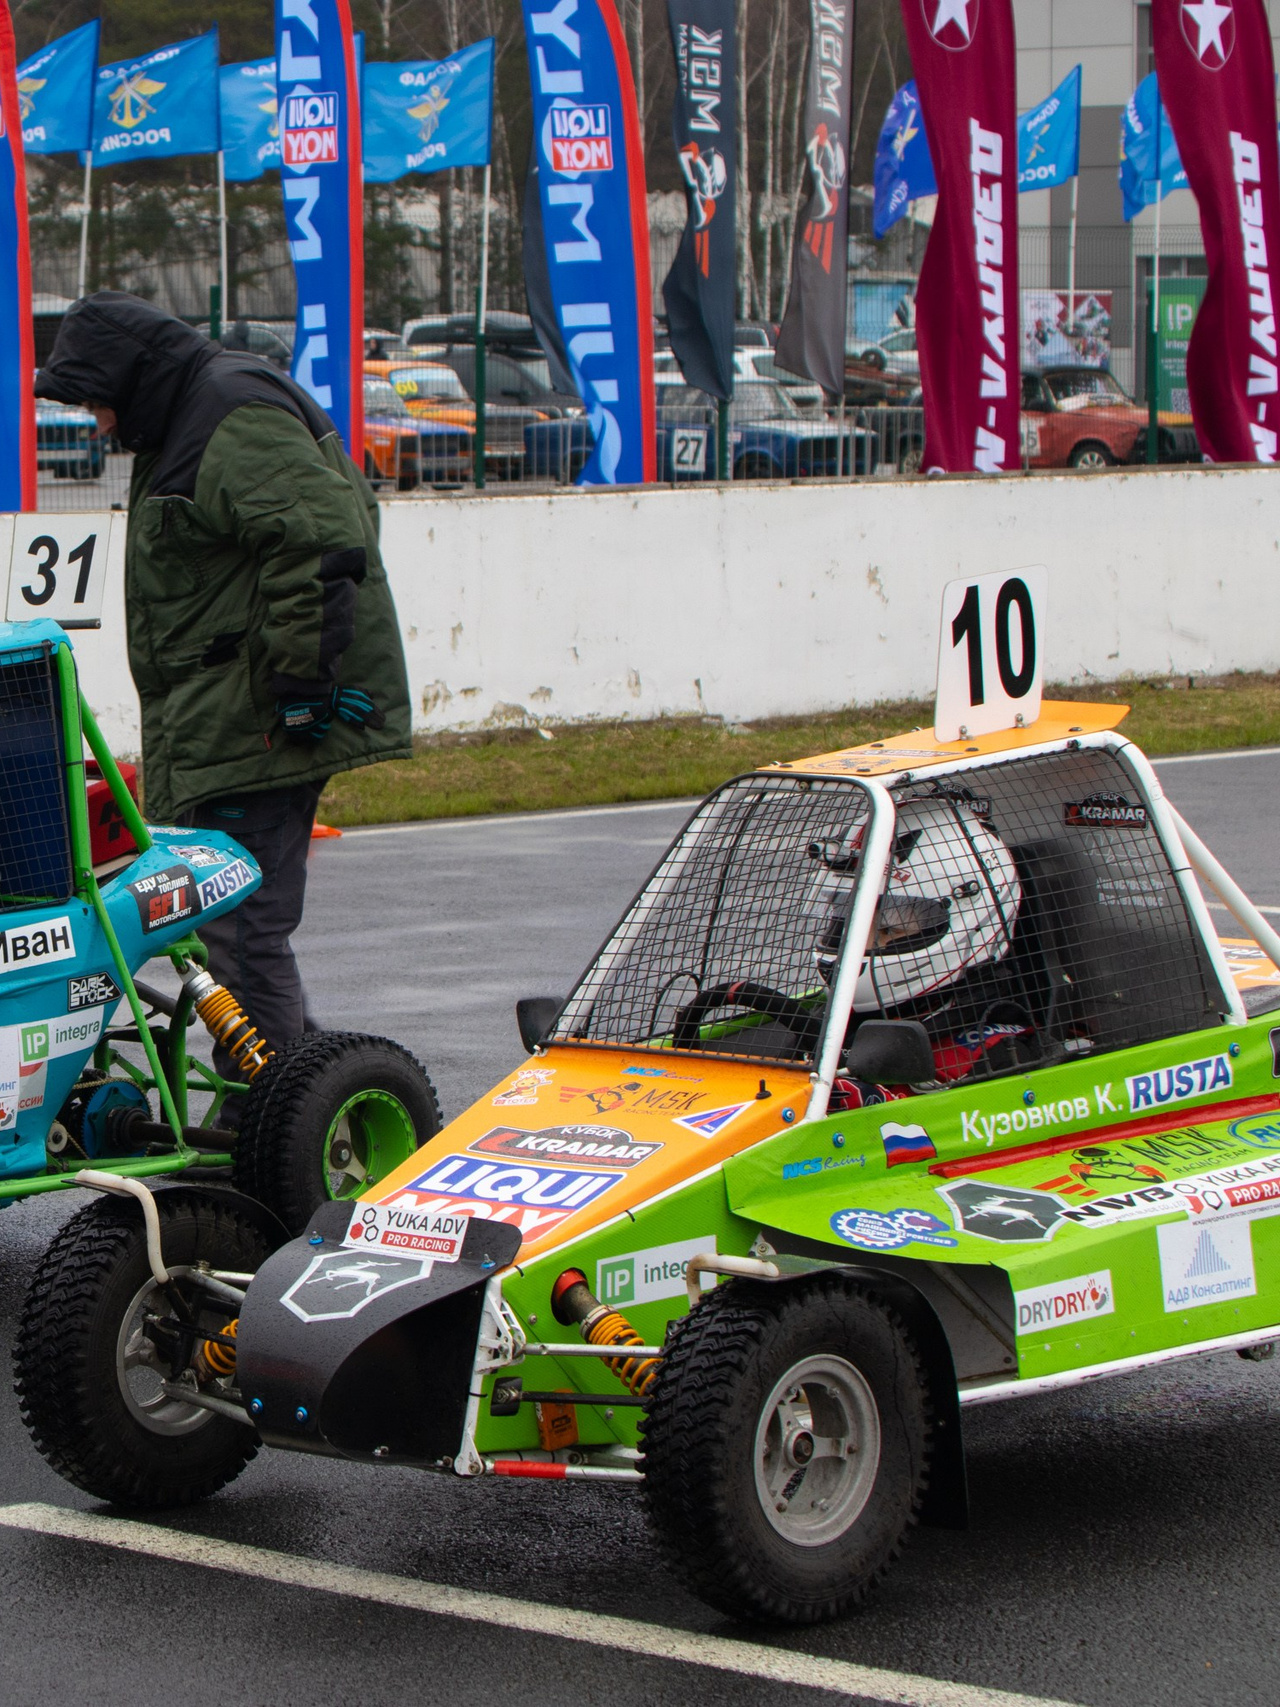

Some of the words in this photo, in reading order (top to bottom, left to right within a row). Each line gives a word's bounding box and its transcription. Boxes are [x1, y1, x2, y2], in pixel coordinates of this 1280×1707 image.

[676, 436, 703, 466] 27
[21, 534, 97, 605] 31
[951, 577, 1037, 707] 10
[1082, 806, 1146, 821] KRAMAR
[135, 877, 157, 894] ЕДУ
[157, 873, 170, 883] НА
[158, 875, 190, 894] ТОПЛИВЕ
[202, 862, 253, 908] RUSTA
[149, 906, 192, 929] MOTORSPORT
[26, 1032, 47, 1055] IP
[56, 1019, 101, 1045] integra
[1132, 1056, 1232, 1110] RUSTA
[633, 1088, 711, 1111] MSK
[960, 1096, 1090, 1146] Кузовков
[1094, 1082, 1124, 1116] К.
[561, 1126, 620, 1140] КУБОК
[1121, 1127, 1238, 1167] MSK
[516, 1136, 653, 1160] KRAMAR
[1172, 1154, 1220, 1175] RACING
[1219, 1148, 1253, 1164] TEAM
[782, 1156, 823, 1180] NCS
[823, 1153, 867, 1170] Racing
[1199, 1166, 1266, 1187] YUKA
[417, 1157, 612, 1207] LIQUI
[1232, 1186, 1260, 1204] PRO
[1061, 1186, 1175, 1222] NWB
[385, 1210, 429, 1230] YUKA
[431, 1214, 466, 1236] ADV
[387, 1234, 409, 1247] PRO
[410, 1236, 451, 1252] RACING
[606, 1268, 631, 1298] IP
[1167, 1288, 1191, 1305] АДВ
[1191, 1276, 1252, 1298] Консалтинг
[1019, 1289, 1088, 1327] DRYDRY
